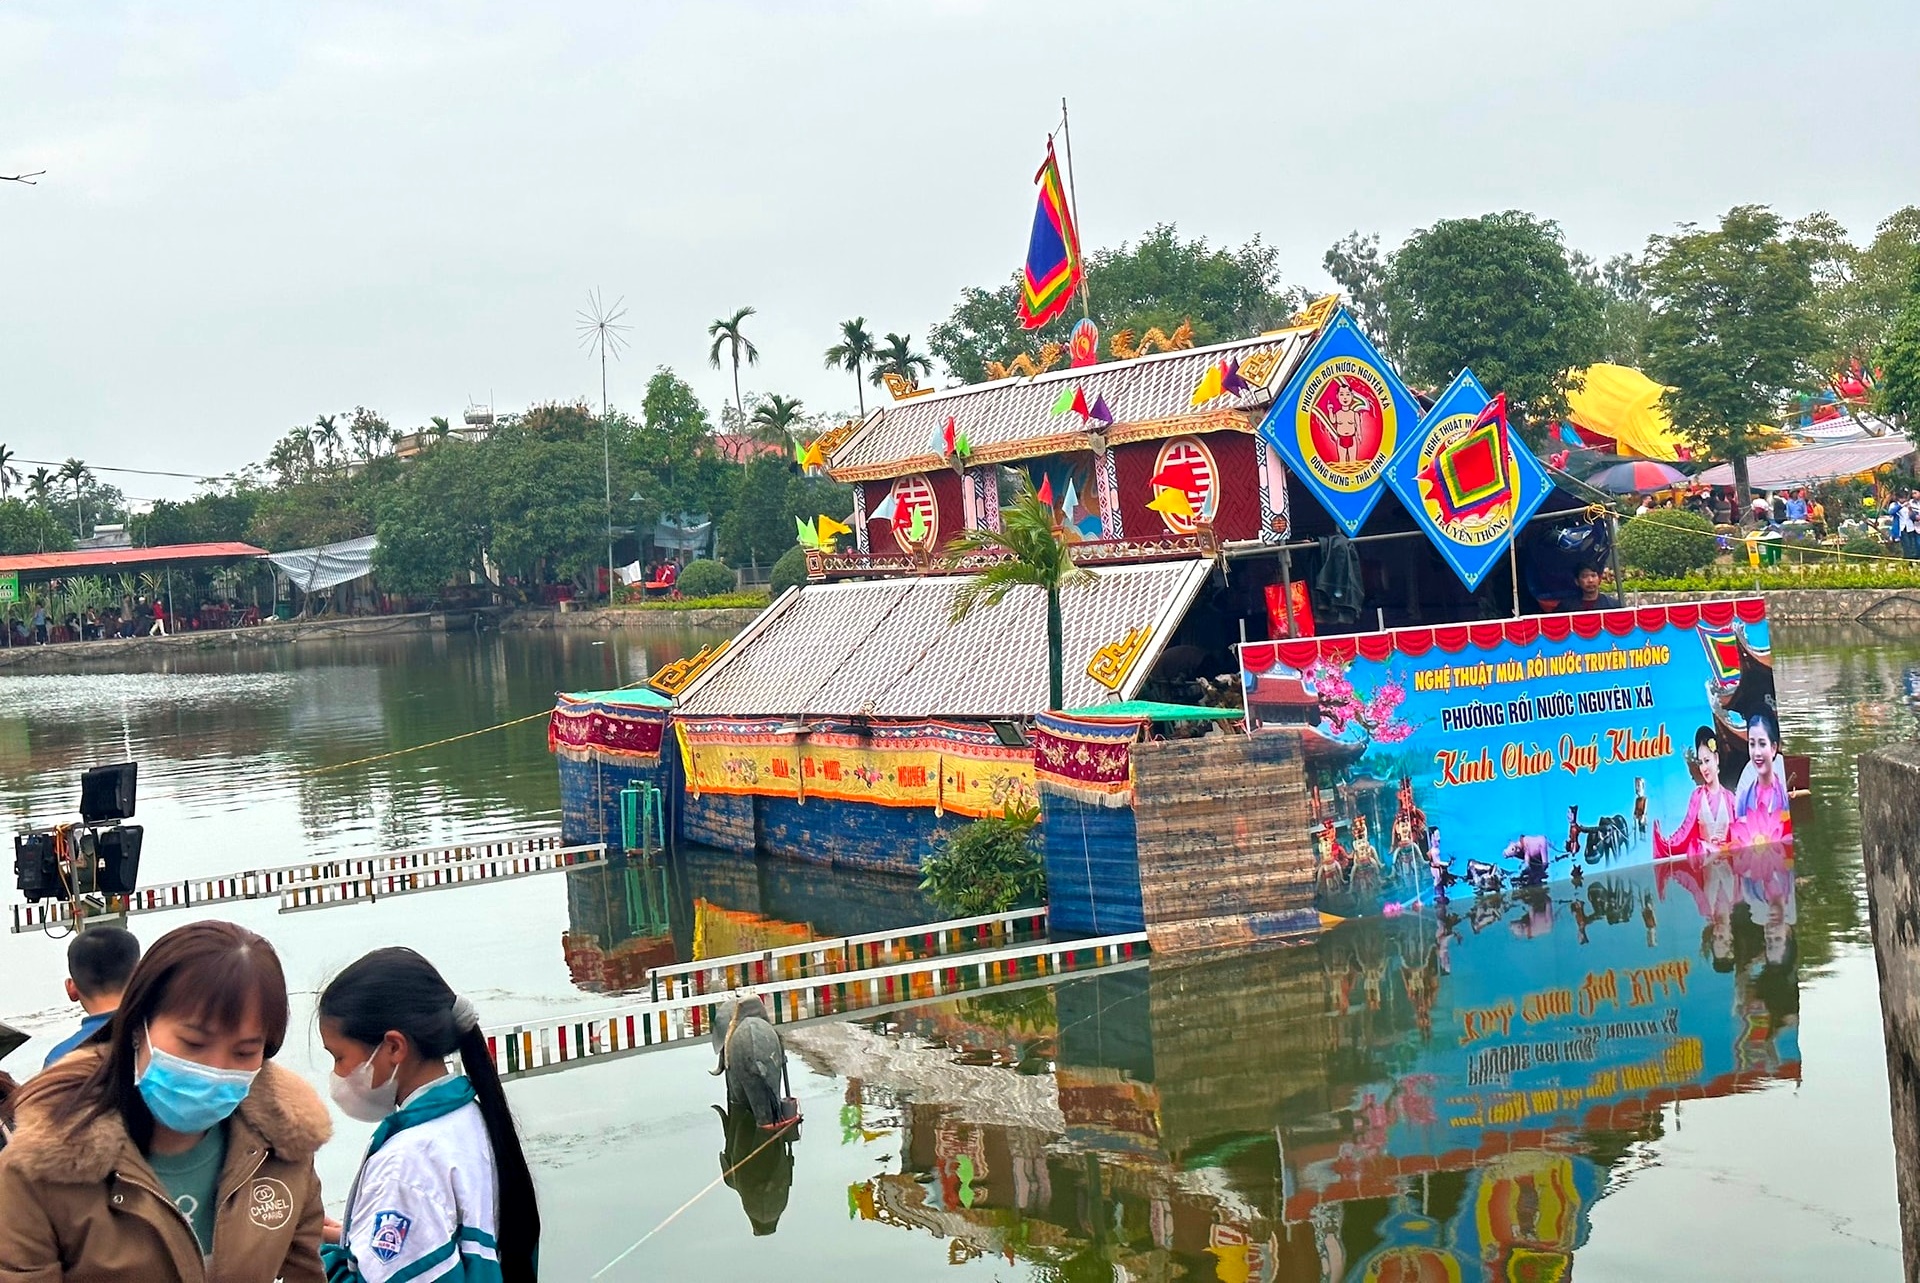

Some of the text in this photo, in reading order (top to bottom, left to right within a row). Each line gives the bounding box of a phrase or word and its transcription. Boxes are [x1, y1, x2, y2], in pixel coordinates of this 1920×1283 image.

[1414, 638, 1670, 694] NGHỆ THUẬT MÚA RỐI NƯỚC TRUYỀN THỐNG
[1441, 682, 1654, 731] PHƯỜNG RỐI NƯỚC NGUYÊN XÁ
[1434, 722, 1673, 787] Kính Chào Quý Khách
[250, 1199, 290, 1217] CHANEL
[262, 1210, 284, 1221] PARIS
